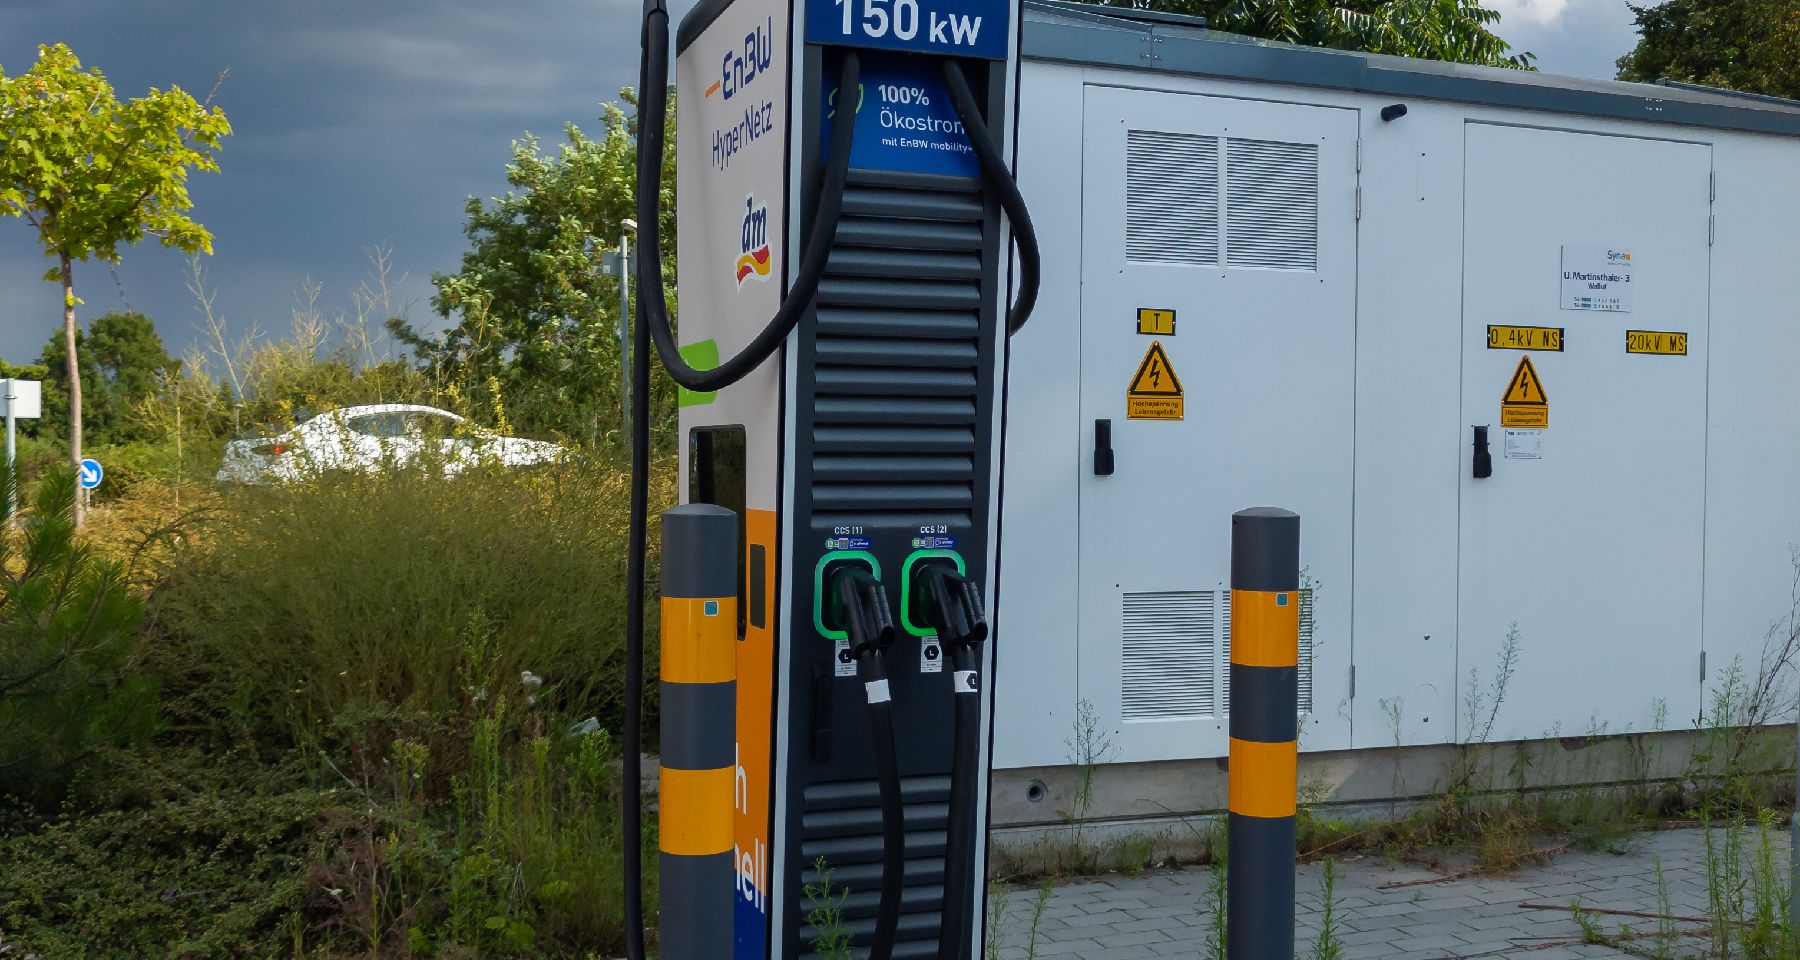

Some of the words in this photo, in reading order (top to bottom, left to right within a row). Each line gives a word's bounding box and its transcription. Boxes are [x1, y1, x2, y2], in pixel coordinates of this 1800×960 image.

[835, 0, 919, 41] 150
[929, 12, 983, 46] kW
[722, 14, 772, 101] EnBW
[879, 84, 930, 106] 100%
[711, 100, 773, 171] HyperNetz
[882, 137, 898, 147] mit
[900, 137, 929, 149] EnBW
[742, 197, 767, 253] dm
[1607, 249, 1626, 261] Syna
[1625, 274, 1631, 283] 3
[1153, 312, 1161, 331] T
[1542, 331, 1558, 348] NS
[1629, 333, 1660, 351] 20kV
[1669, 335, 1685, 352] MS
[834, 526, 850, 535] CCS
[852, 526, 863, 535] (1)
[920, 525, 935, 534] CCS
[937, 525, 947, 534] (2)
[929, 649, 935, 657] L
